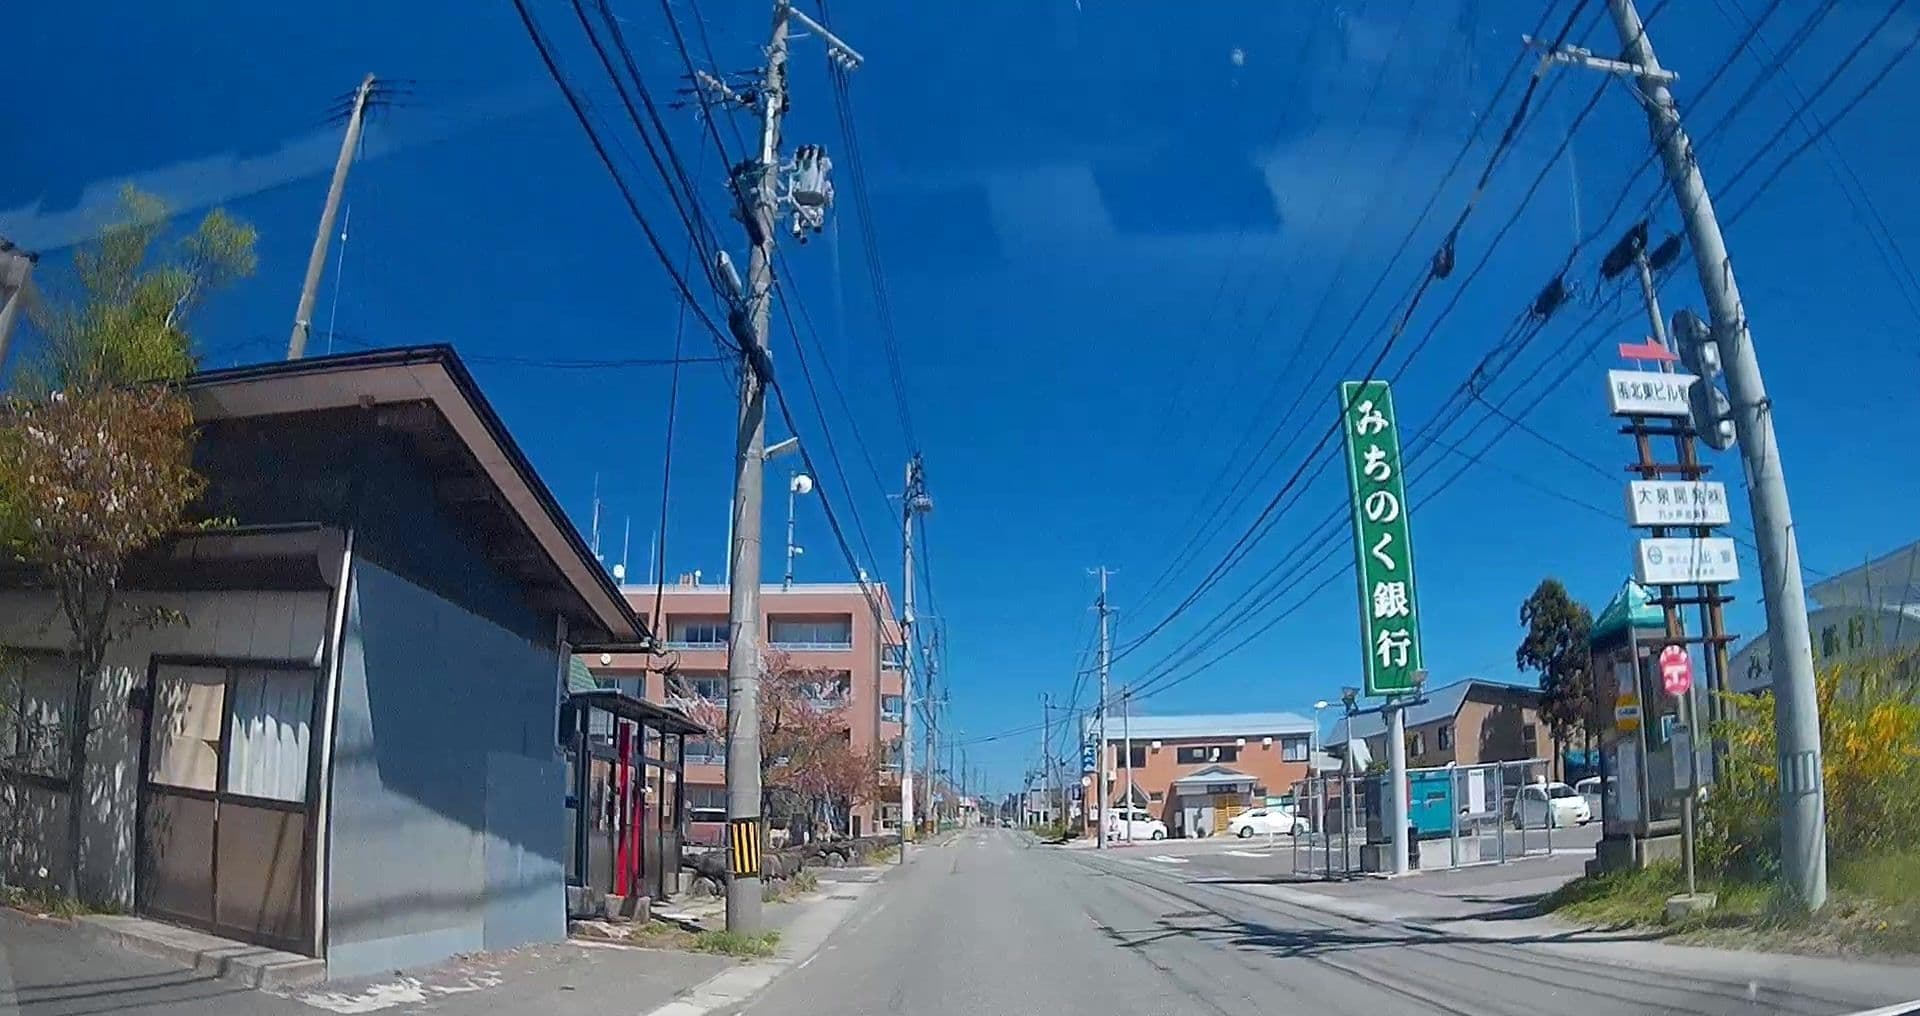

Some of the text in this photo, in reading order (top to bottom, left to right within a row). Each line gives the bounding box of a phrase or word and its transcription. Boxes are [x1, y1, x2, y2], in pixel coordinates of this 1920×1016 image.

[1356, 399, 1412, 668] みちのく銀行
